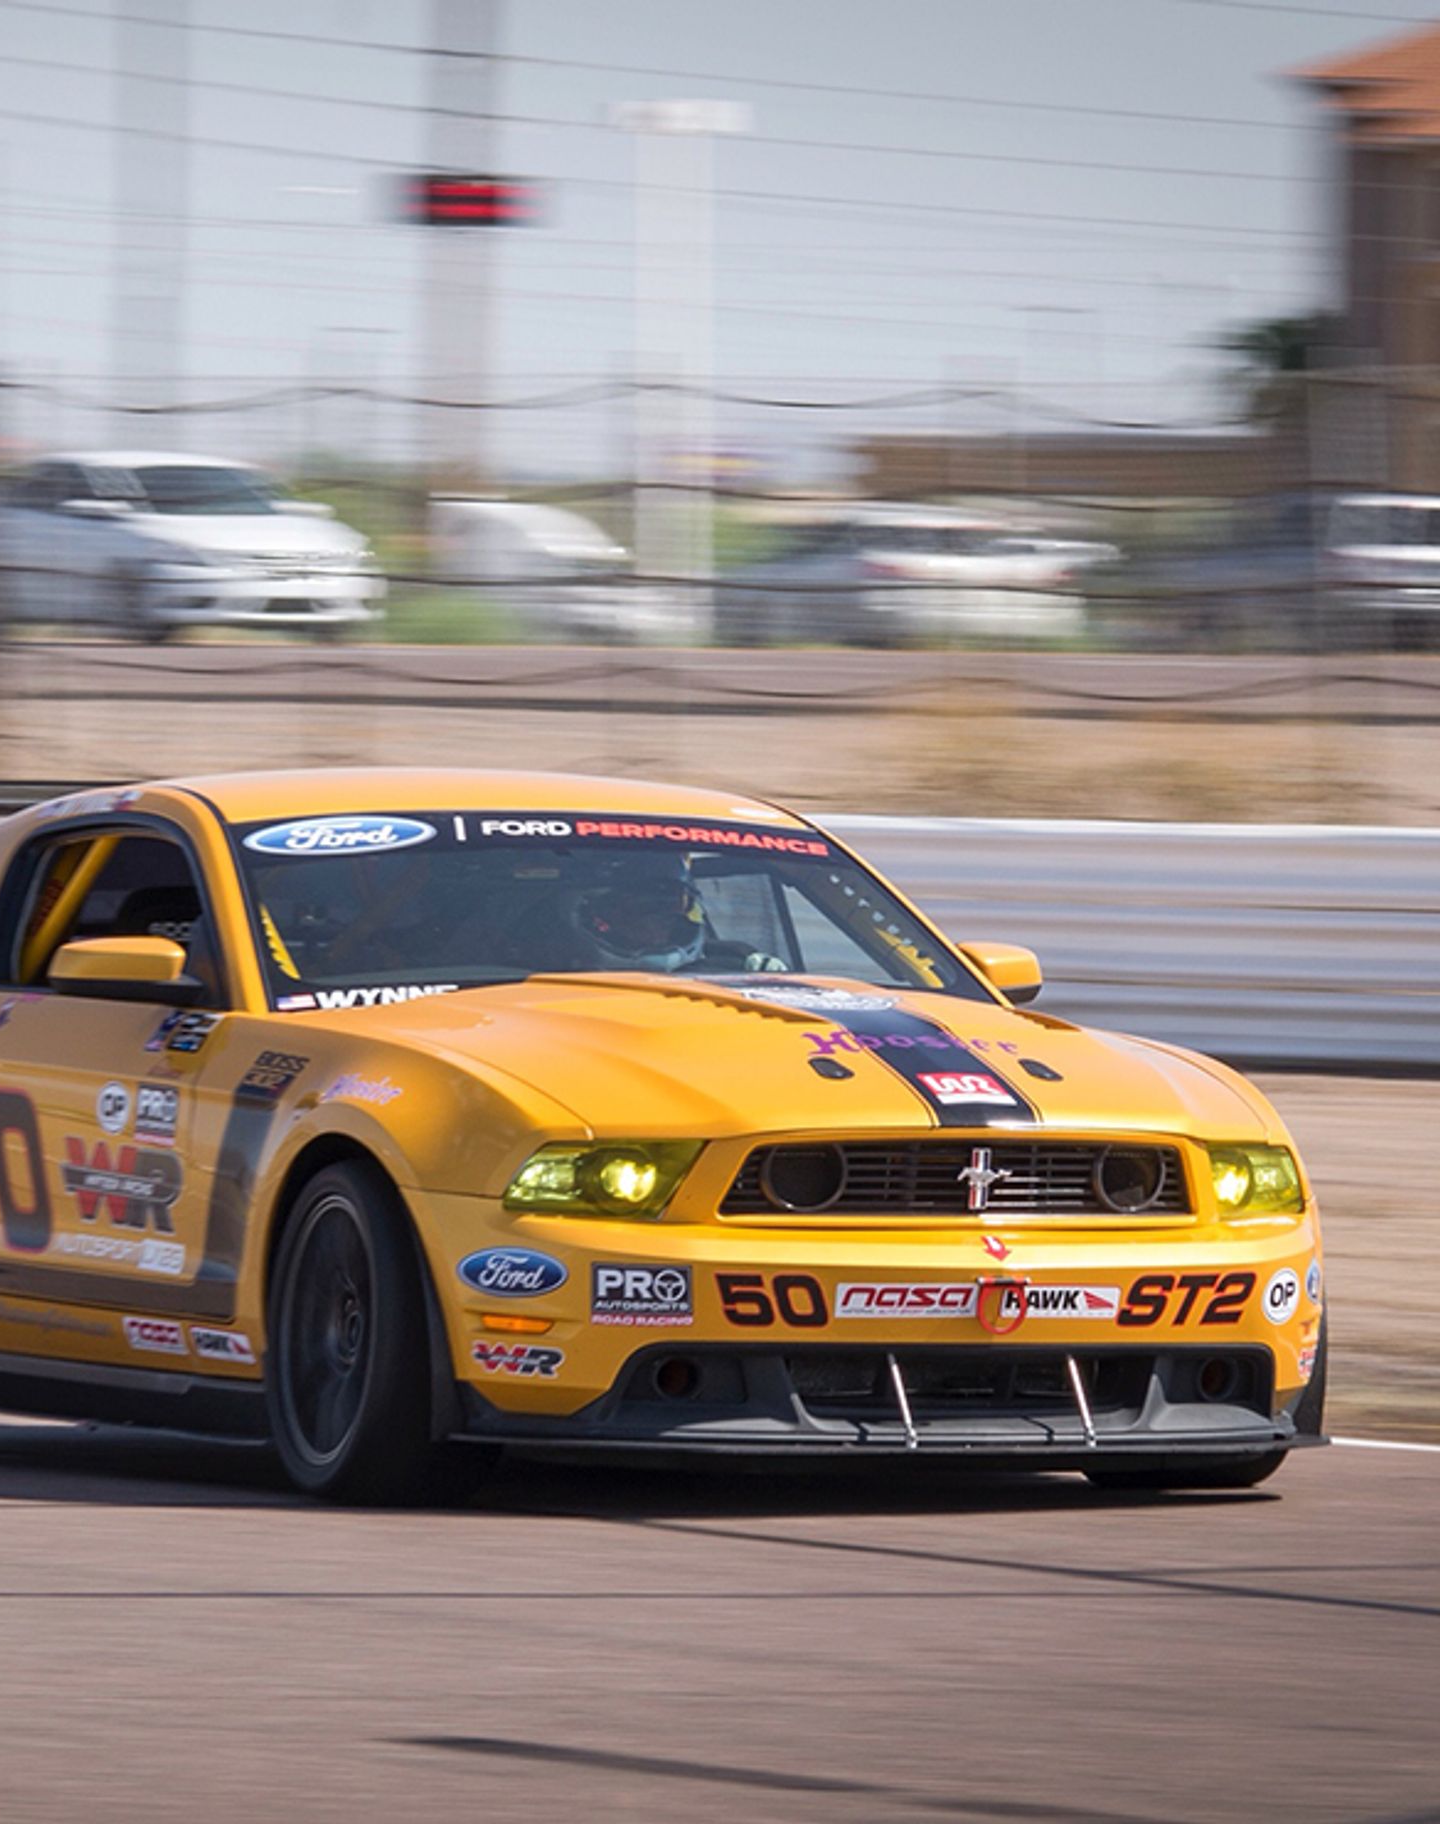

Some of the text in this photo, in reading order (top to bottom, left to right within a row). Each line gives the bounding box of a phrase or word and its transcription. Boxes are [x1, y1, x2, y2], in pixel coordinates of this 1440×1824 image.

[285, 822, 399, 850] Ford
[481, 820, 829, 856] FORD PERFORMANCE
[477, 1254, 546, 1289] Ford
[594, 1300, 690, 1312] AUTOSPORTS
[714, 1273, 829, 1327] 50
[1004, 1290, 1081, 1310] HAWK
[1116, 1271, 1257, 1327] ST2
[1270, 1280, 1296, 1308] OP
[473, 1342, 563, 1376] WR
